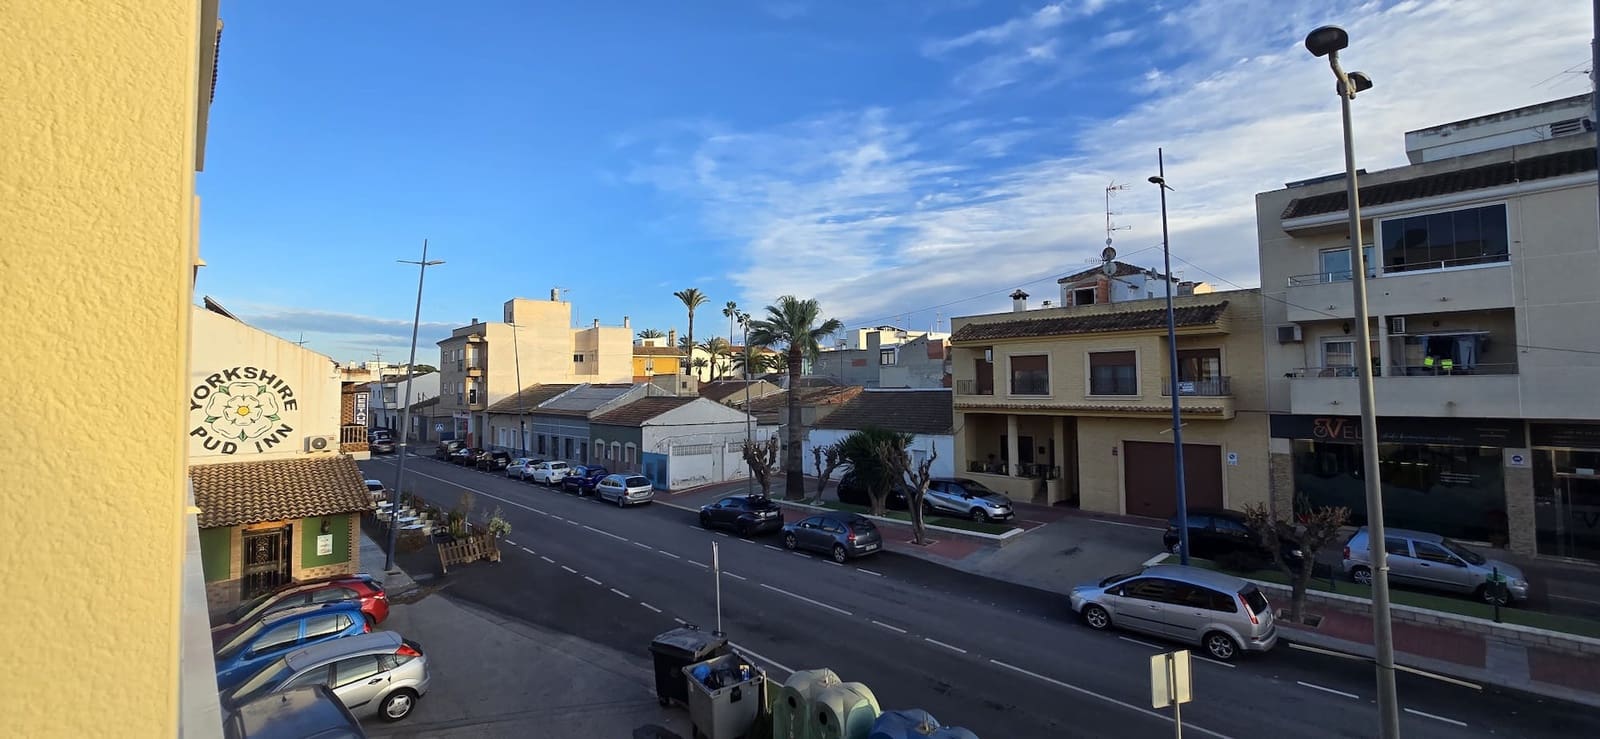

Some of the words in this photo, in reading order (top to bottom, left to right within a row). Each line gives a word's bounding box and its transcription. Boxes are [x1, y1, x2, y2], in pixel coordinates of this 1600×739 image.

[190, 366, 298, 411] YORKSHIRE
[189, 426, 238, 455] PUD
[255, 423, 294, 454] INN
